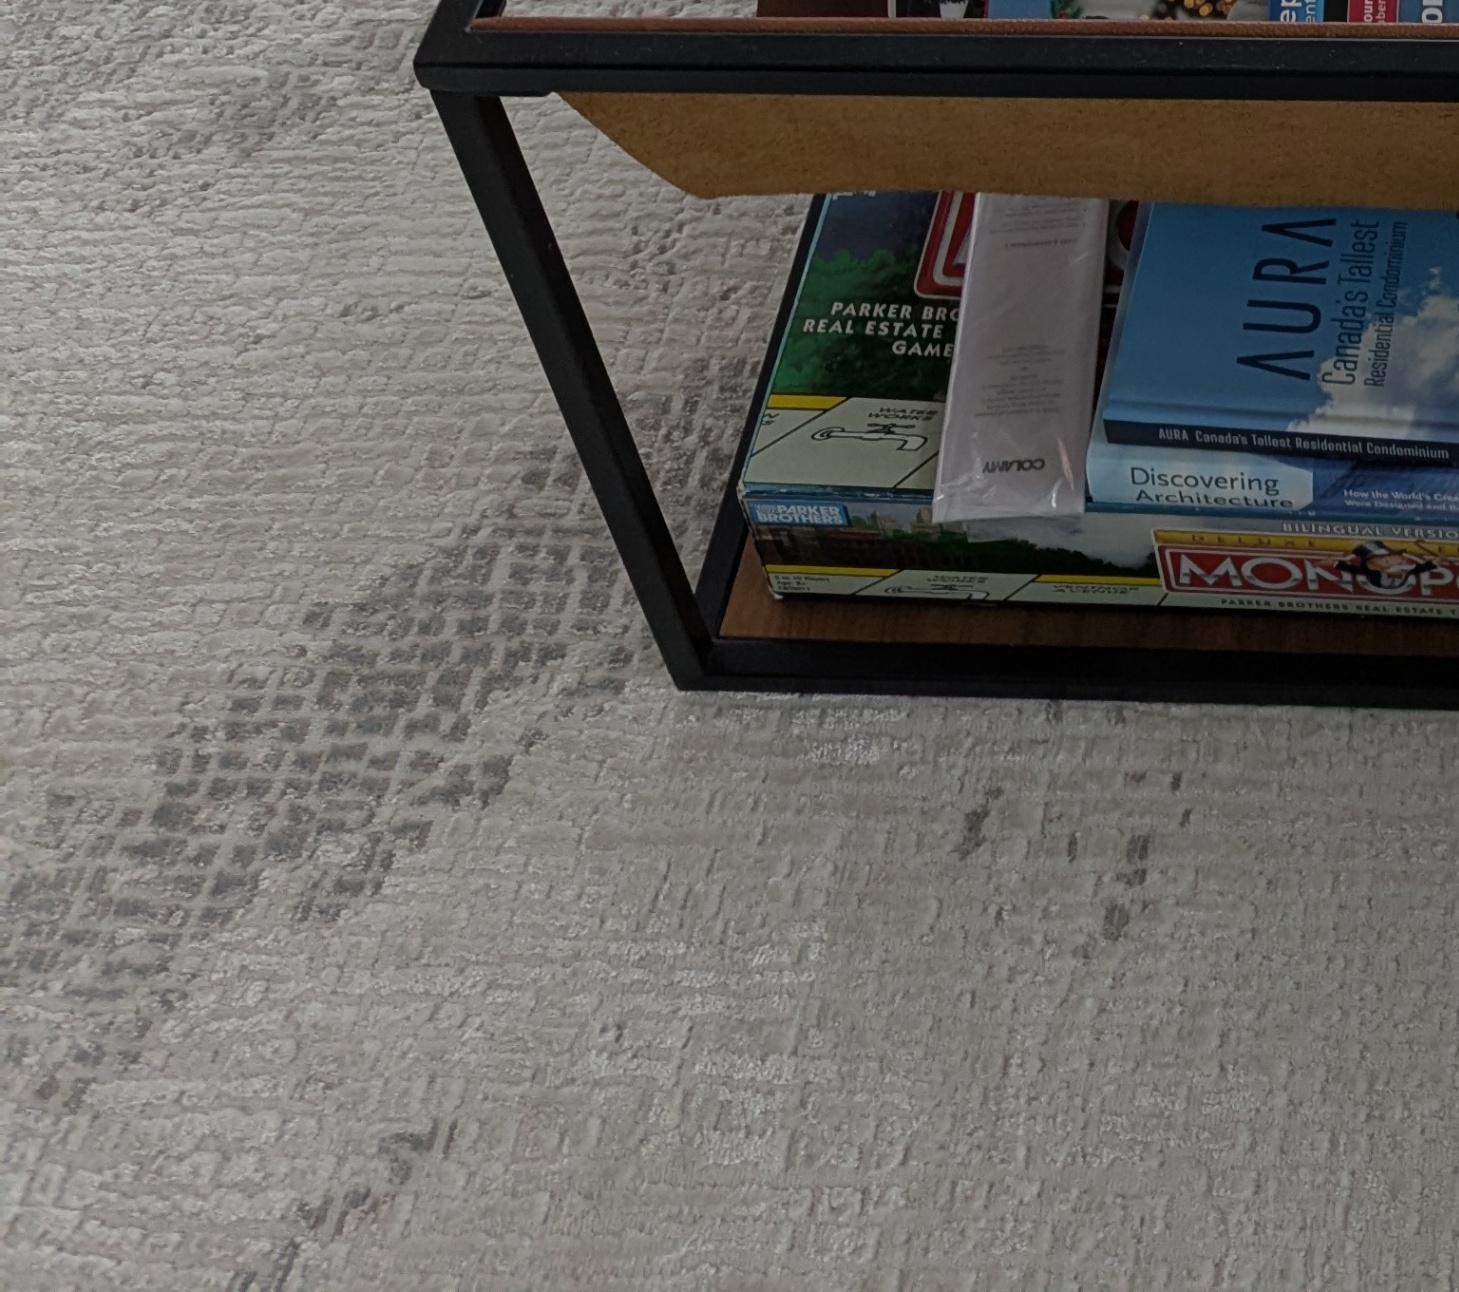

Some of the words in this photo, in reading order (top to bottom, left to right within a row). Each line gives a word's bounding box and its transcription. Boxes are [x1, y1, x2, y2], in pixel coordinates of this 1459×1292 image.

[1335, 219, 1380, 286] Tallest
[1236, 218, 1336, 381] AURA
[1363, 312, 1395, 387] Residential
[1382, 220, 1409, 311] Condominium
[830, 302, 912, 319] PARKER
[803, 318, 854, 335] REAL
[864, 321, 944, 339] ESTATE
[1321, 289, 1369, 386] Canada's
[892, 340, 954, 357] GAME
[1158, 427, 1189, 442] AURA
[1195, 430, 1248, 446] Canada's
[1251, 434, 1291, 449] Tallest
[1295, 437, 1362, 454] Residential
[1366, 441, 1449, 459] Condominium
[1130, 466, 1280, 495] Discovering
[1136, 489, 1293, 508] Architecture
[1343, 489, 1369, 498] How
[1371, 490, 1389, 498] the
[1391, 491, 1432, 501] World's
[777, 504, 839, 516] PARKER
[1344, 499, 1372, 507] Were
[1374, 500, 1423, 511] Designed
[757, 513, 843, 525] BROTHERS
[1282, 522, 1382, 536] BILINGUAL
[1192, 534, 1317, 547] DELUXE
[1220, 598, 1271, 608] PARKER
[1278, 601, 1349, 611] BROTHERS
[1355, 604, 1389, 613] REAL
[1396, 606, 1443, 616] ESTATE
